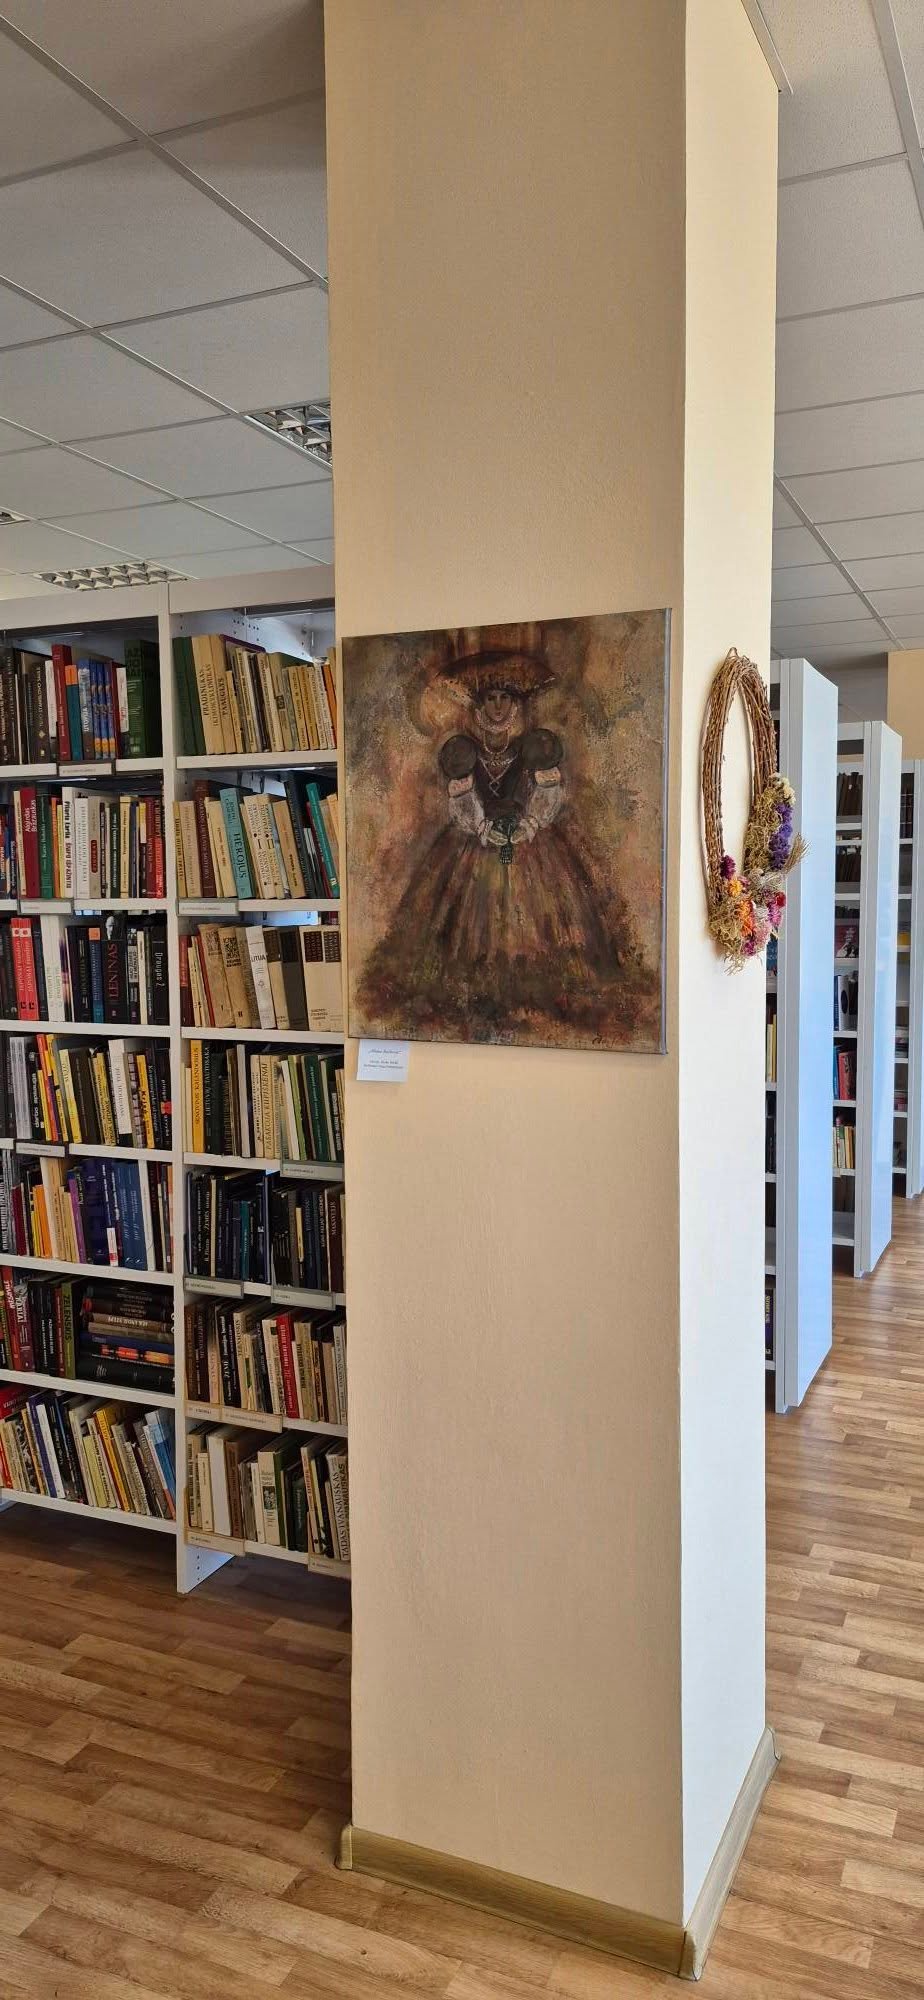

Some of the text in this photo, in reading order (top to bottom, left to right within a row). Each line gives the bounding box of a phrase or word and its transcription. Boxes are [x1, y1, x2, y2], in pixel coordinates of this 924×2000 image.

[199, 669, 210, 716] PRADINUKAS
[218, 678, 228, 716] PAAUGLYS
[233, 832, 247, 878] HEROJUS
[108, 943, 118, 997] LENINAS
[154, 952, 164, 981] Draugas
[63, 1294, 72, 1341] ZELENSKIS
[332, 1472, 350, 1557] TADAS IVANAUSKAS
